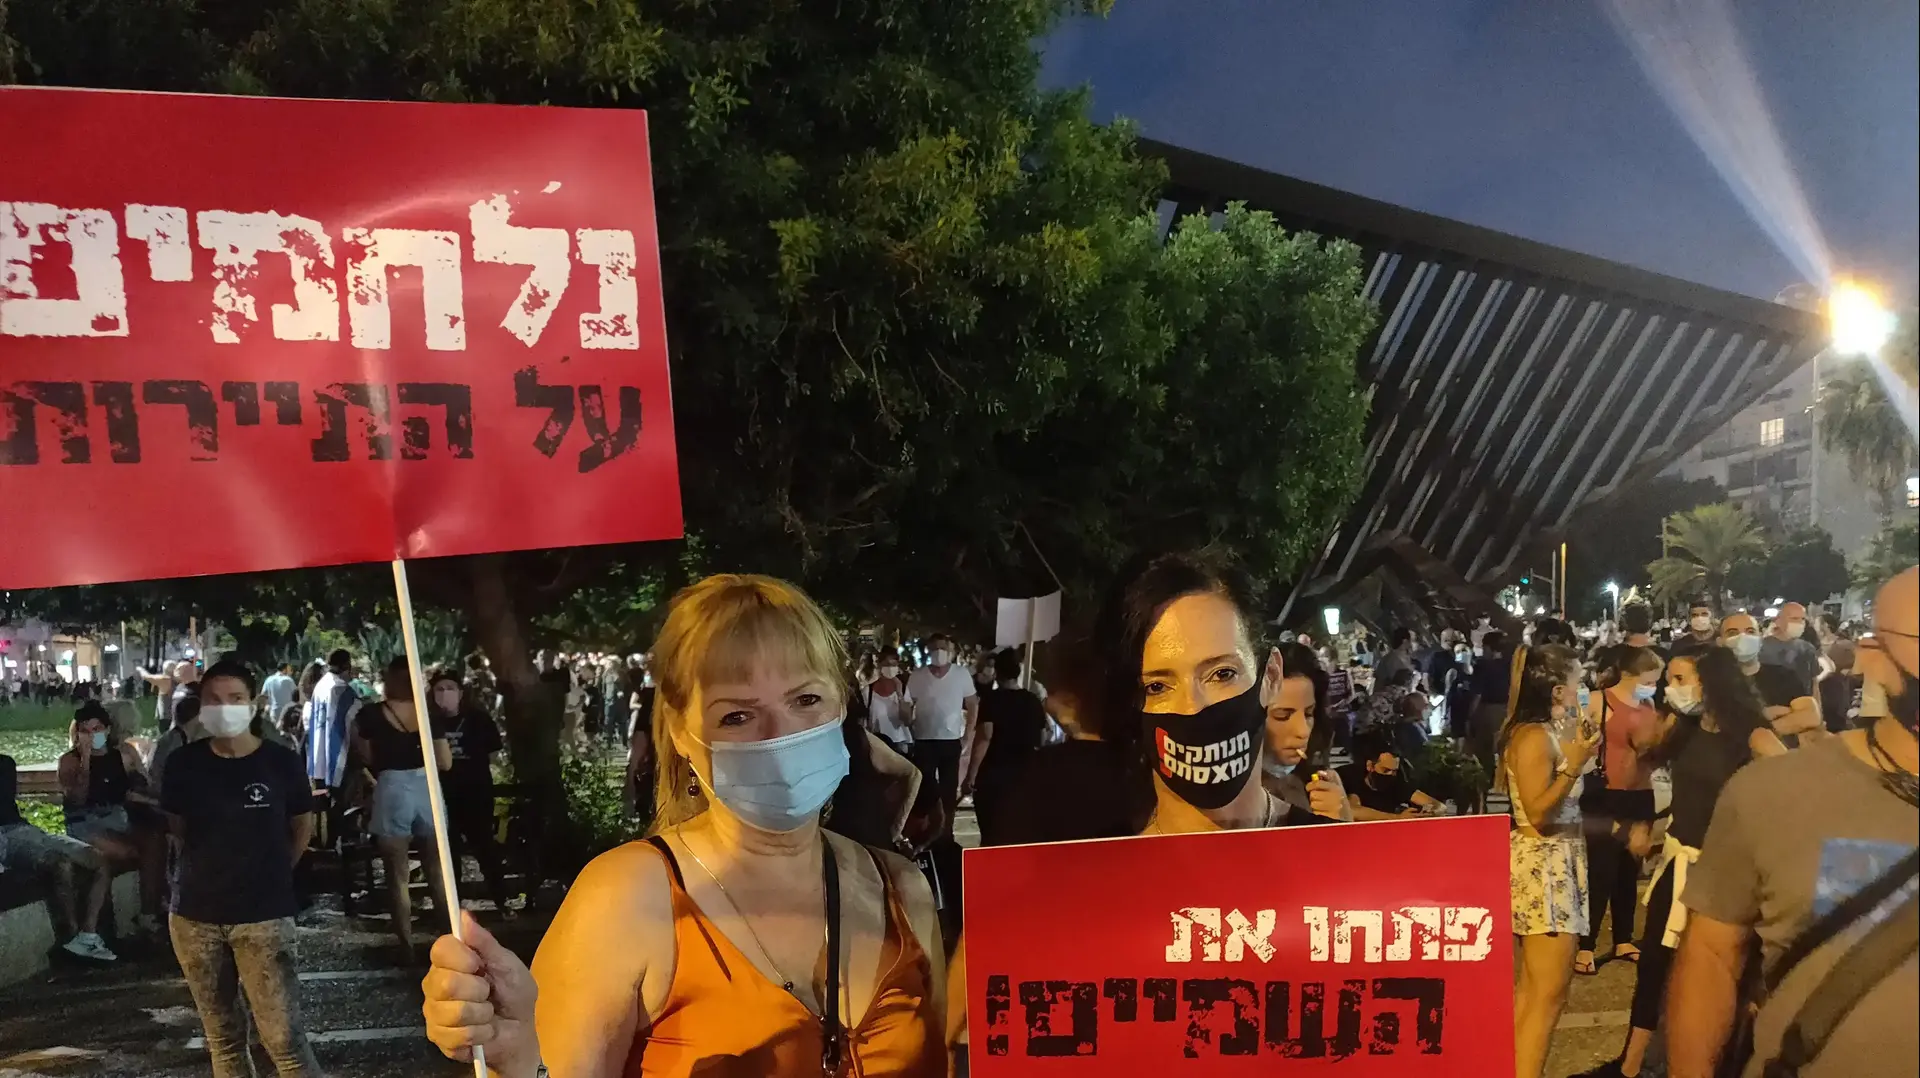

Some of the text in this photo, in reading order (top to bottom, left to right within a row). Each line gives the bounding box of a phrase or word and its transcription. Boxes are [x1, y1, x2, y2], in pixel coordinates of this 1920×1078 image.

[0, 190, 640, 350] נלחמים
[0, 364, 642, 473] על התיירות
[1163, 730, 1251, 764] מנותקים
[1163, 752, 1250, 785] נמאסתם
[1165, 905, 1494, 964] פתחו את
[986, 974, 1447, 1063] השמיים!
